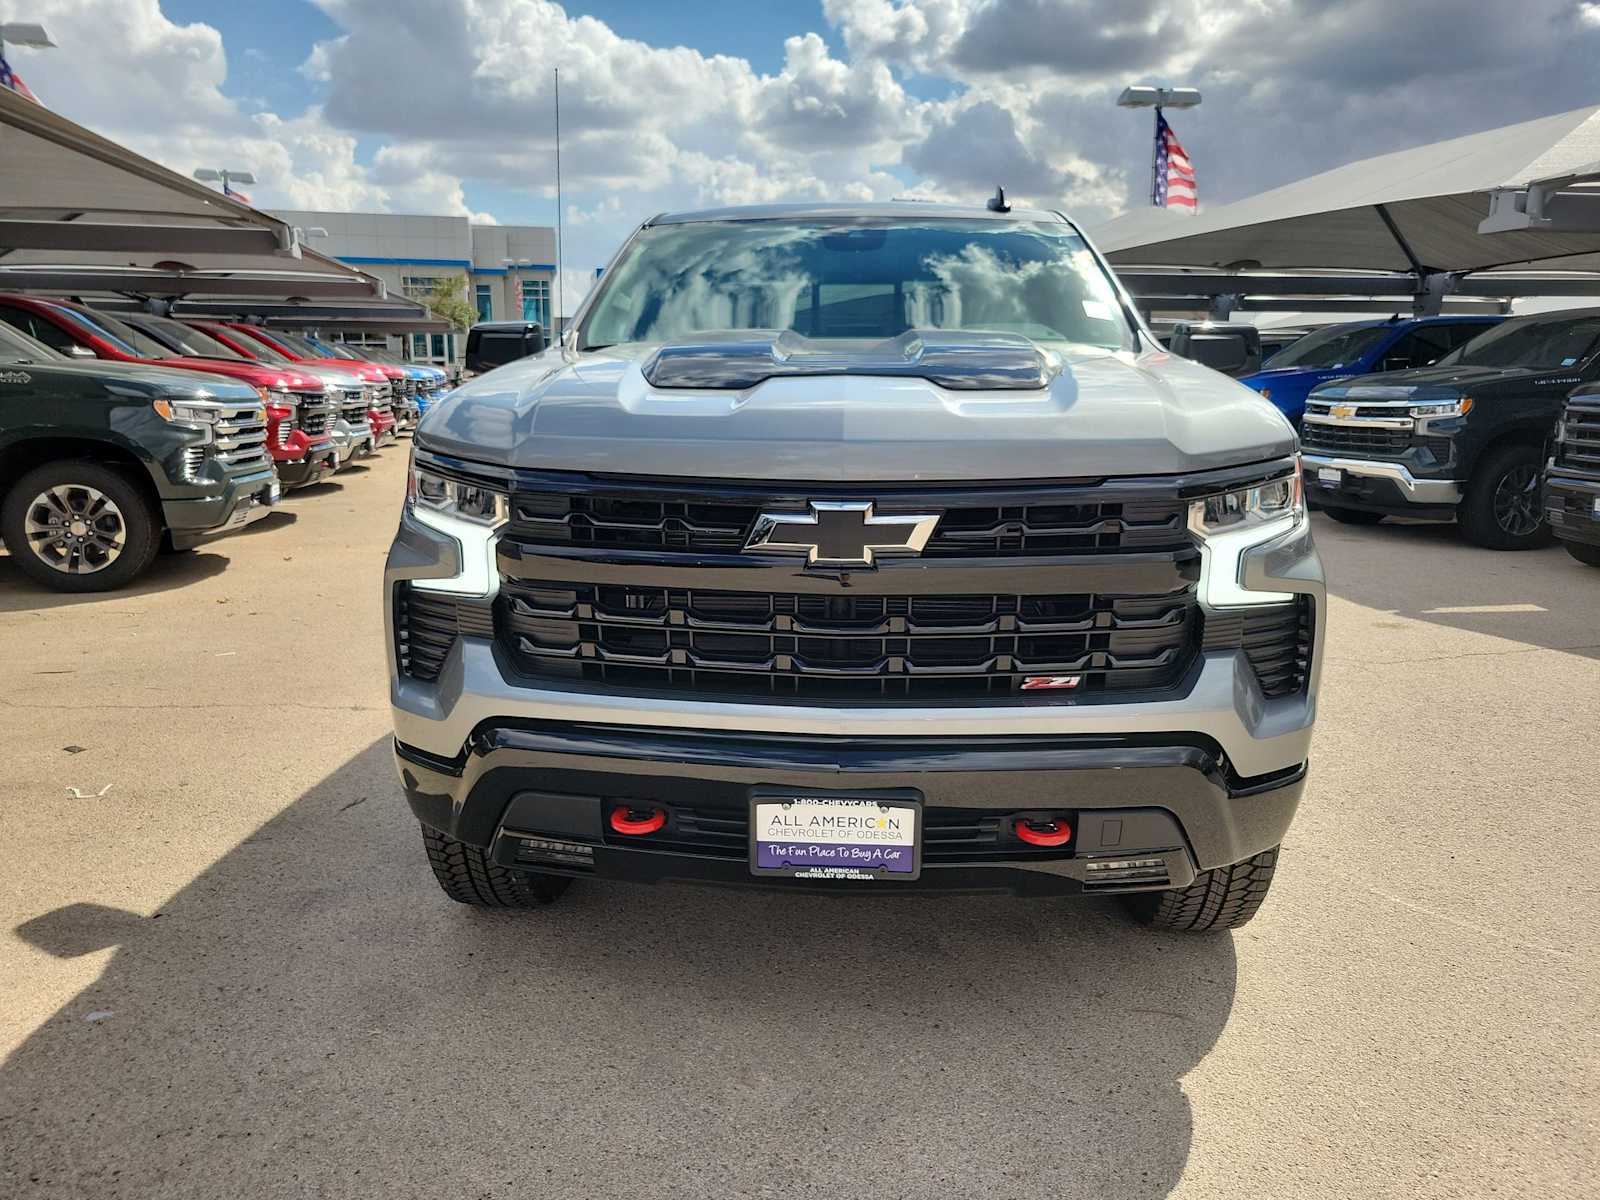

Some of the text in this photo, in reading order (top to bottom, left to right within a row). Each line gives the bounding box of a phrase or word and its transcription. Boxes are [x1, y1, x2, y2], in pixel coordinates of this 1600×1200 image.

[771, 815, 900, 829] ALL AMERICN
[768, 828, 903, 840] CHEVROLET OF ODESSA
[768, 844, 902, 862] The Fun Place To Buy A Car
